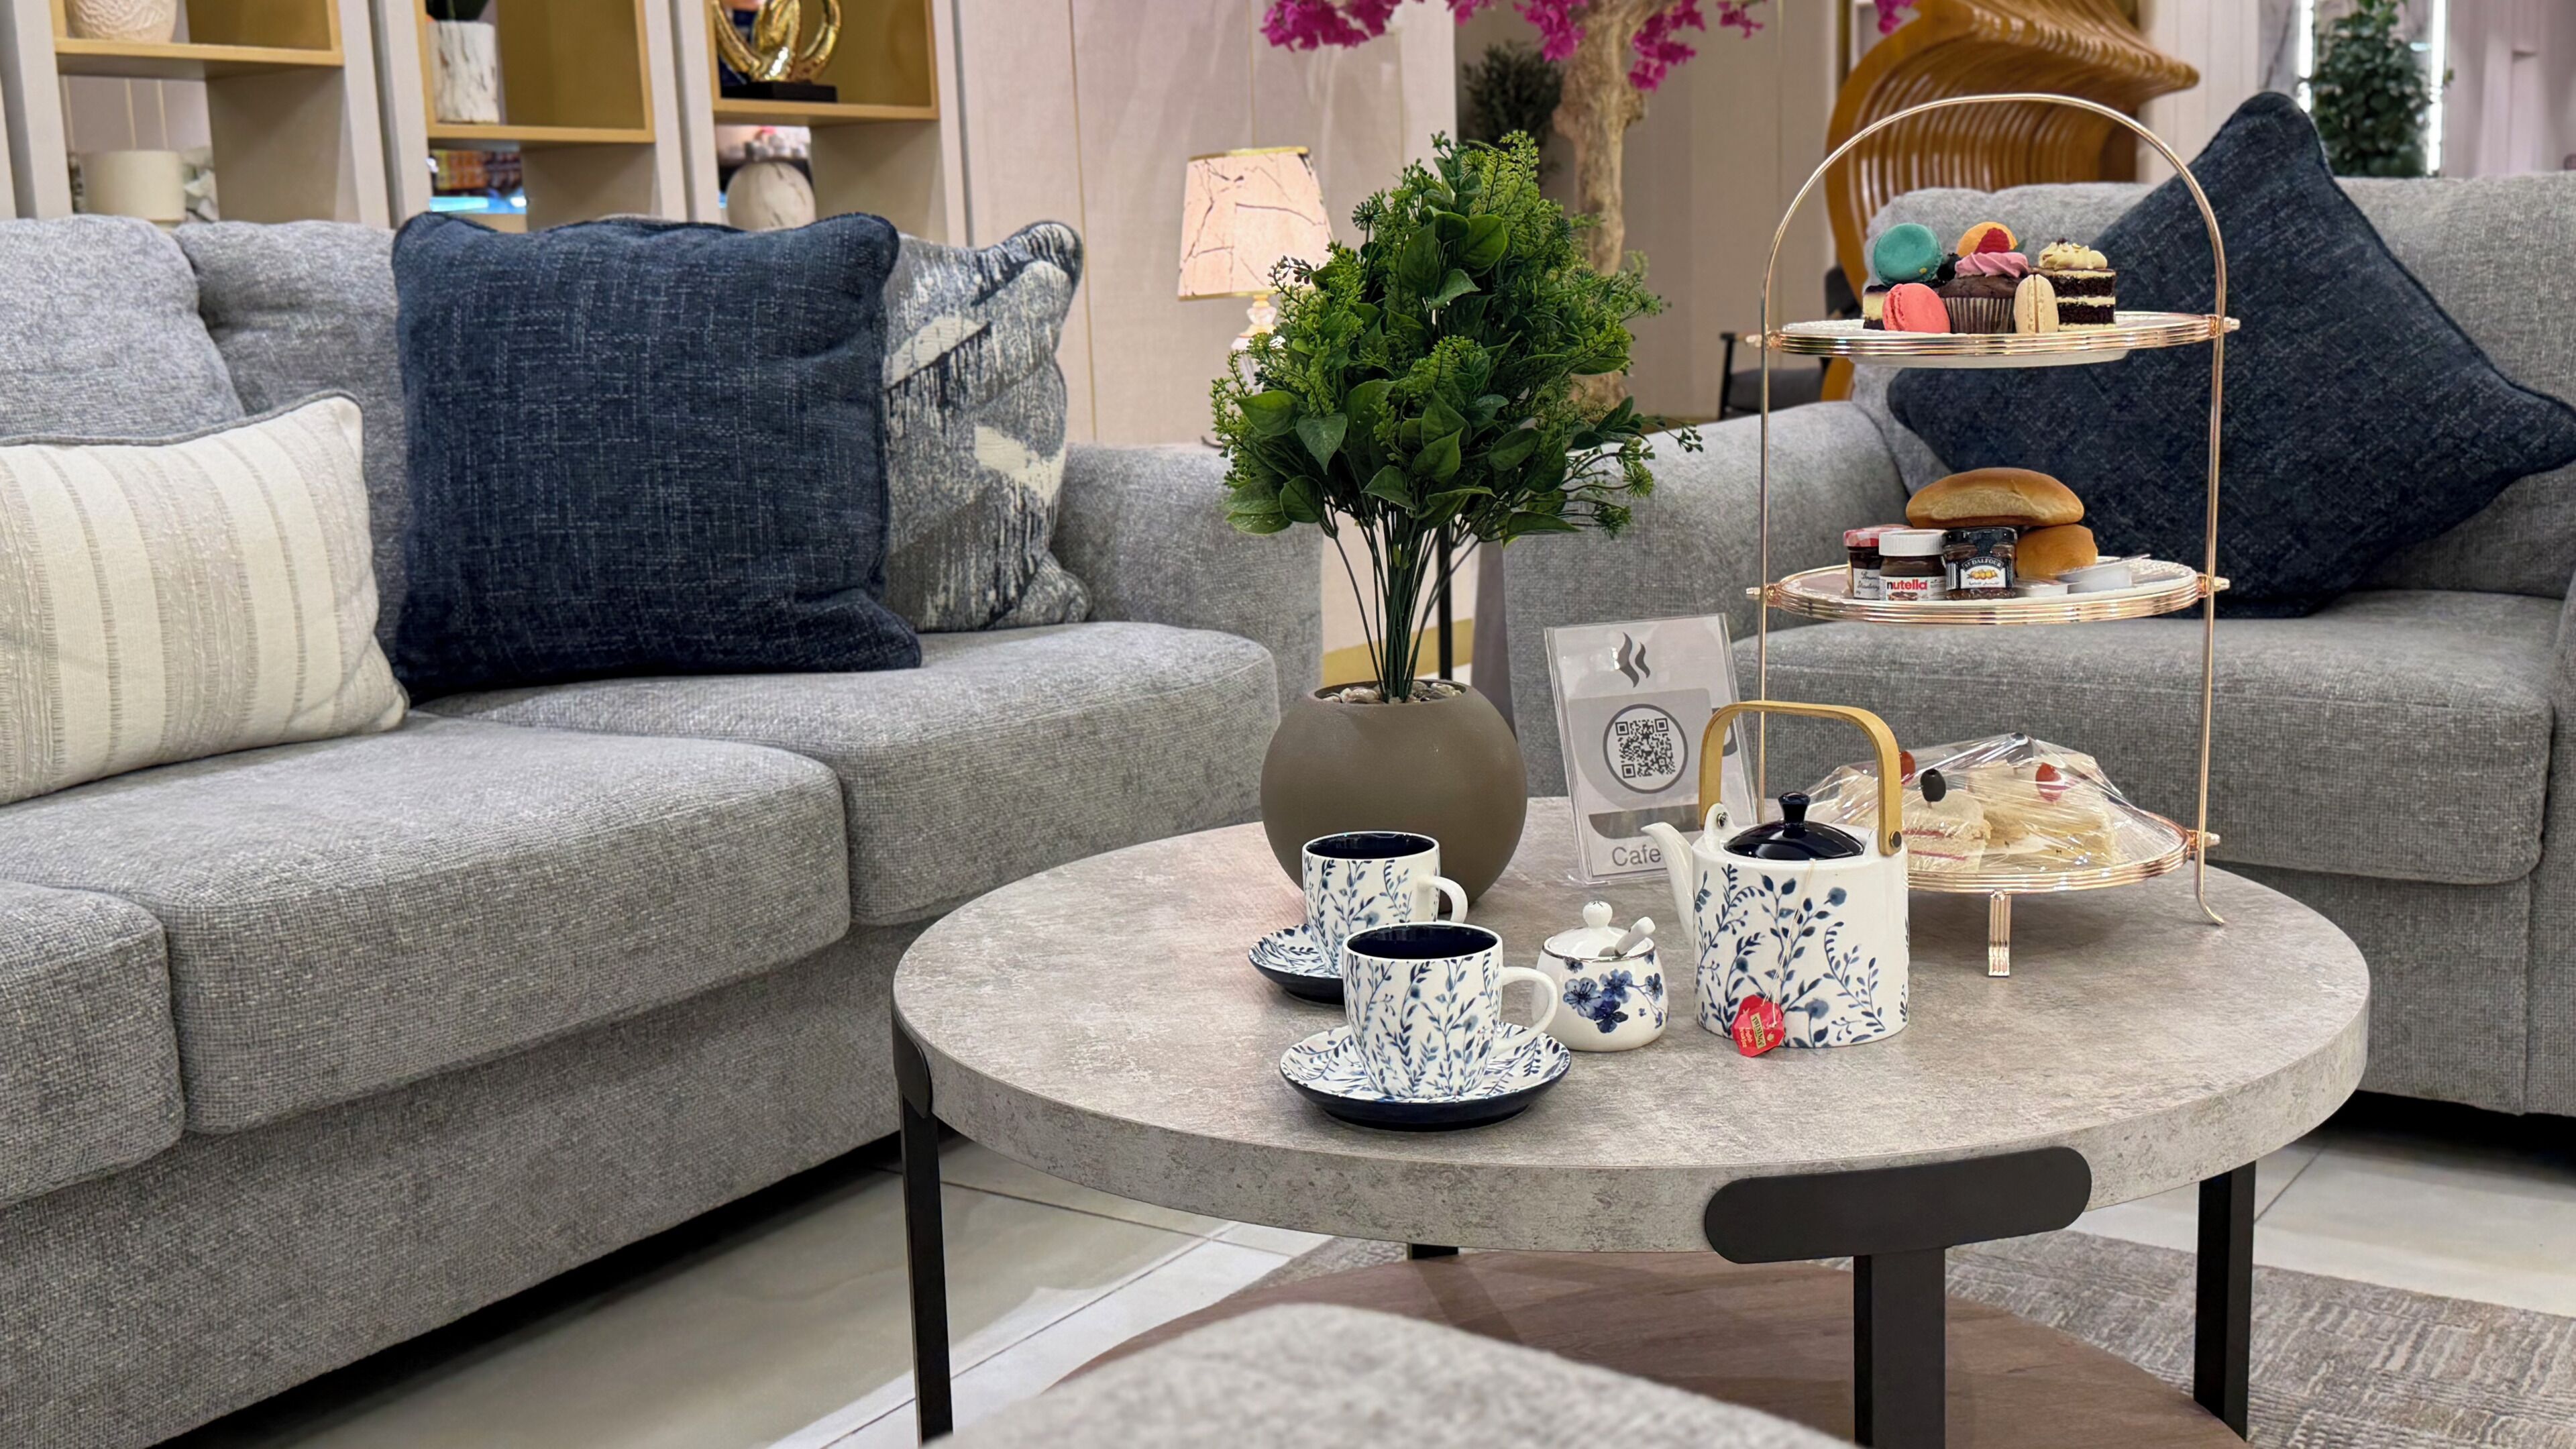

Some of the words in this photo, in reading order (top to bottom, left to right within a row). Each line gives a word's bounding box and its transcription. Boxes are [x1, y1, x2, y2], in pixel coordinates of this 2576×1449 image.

[1972, 558, 2002, 568] DALFOUR
[1886, 578, 1927, 590] nutella
[1612, 844, 1661, 867] Cafe
[1752, 1016, 1765, 1046] TWININGS
